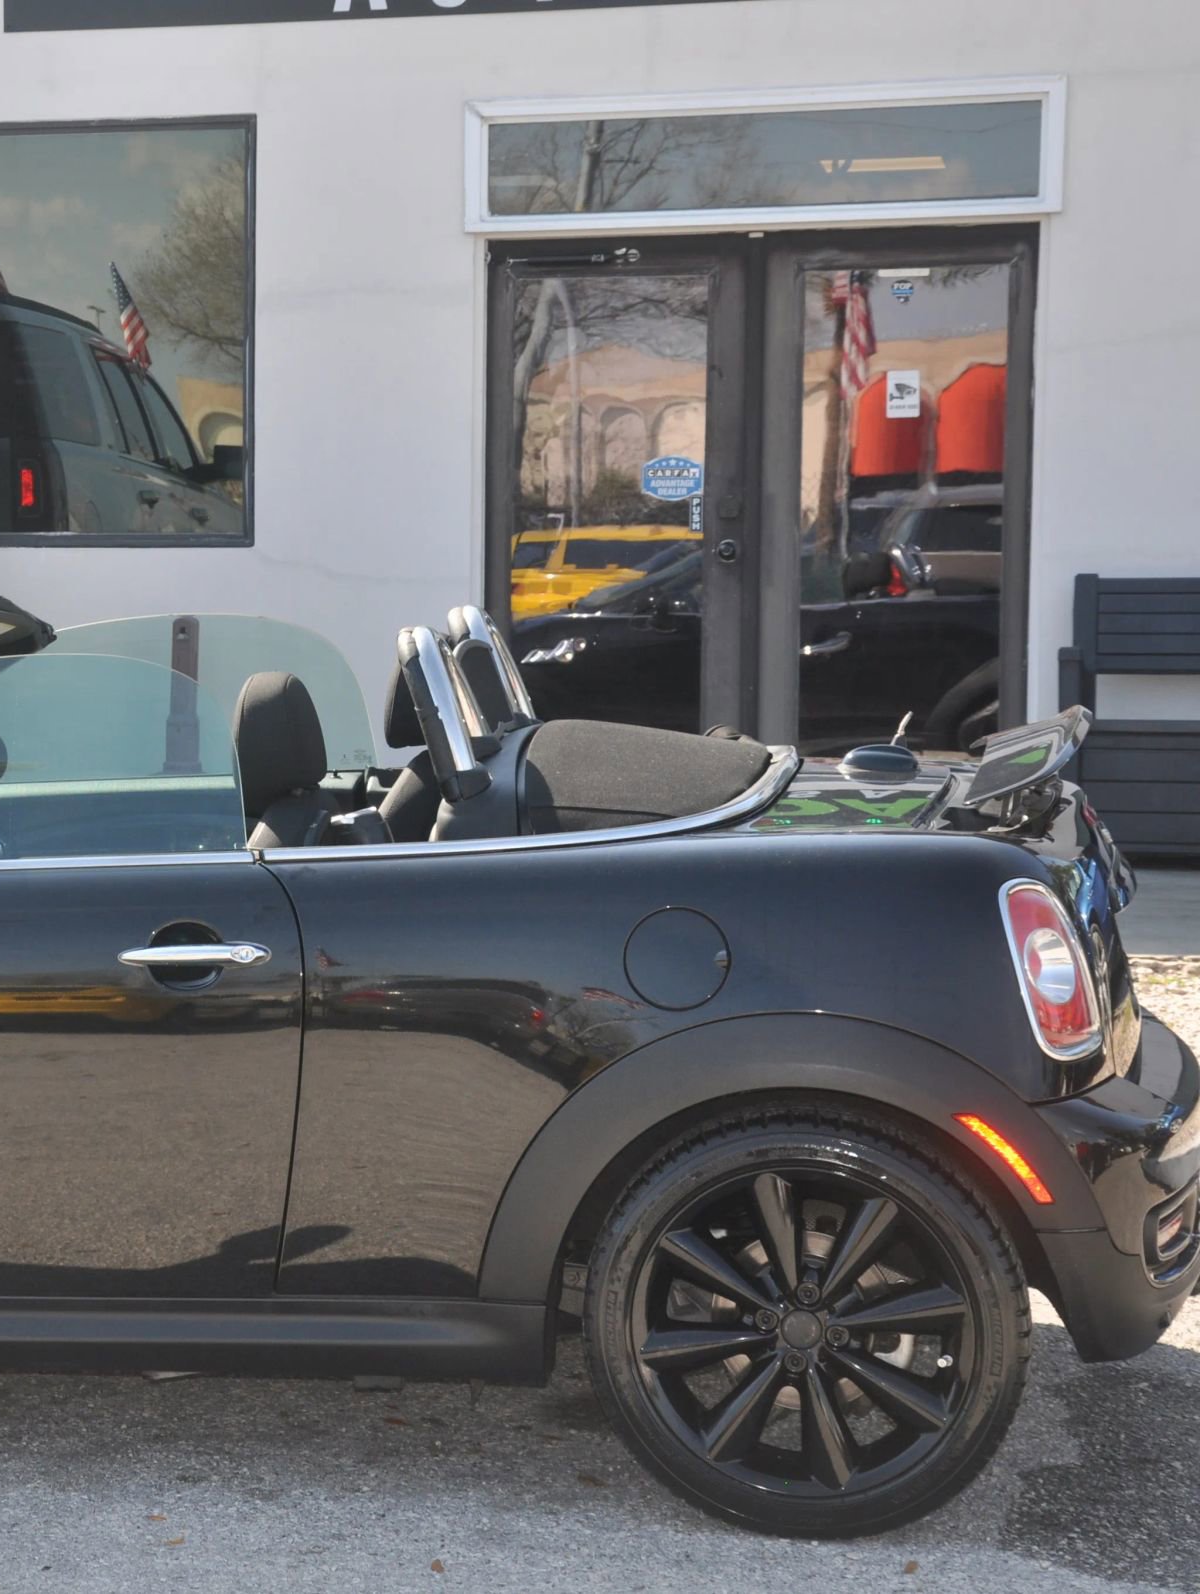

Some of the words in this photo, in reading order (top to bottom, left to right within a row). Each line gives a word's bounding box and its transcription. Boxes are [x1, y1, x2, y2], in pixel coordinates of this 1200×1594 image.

[650, 479, 695, 488] ADVANTAGE
[657, 487, 688, 496] DEALER
[692, 497, 701, 530] PUSH
